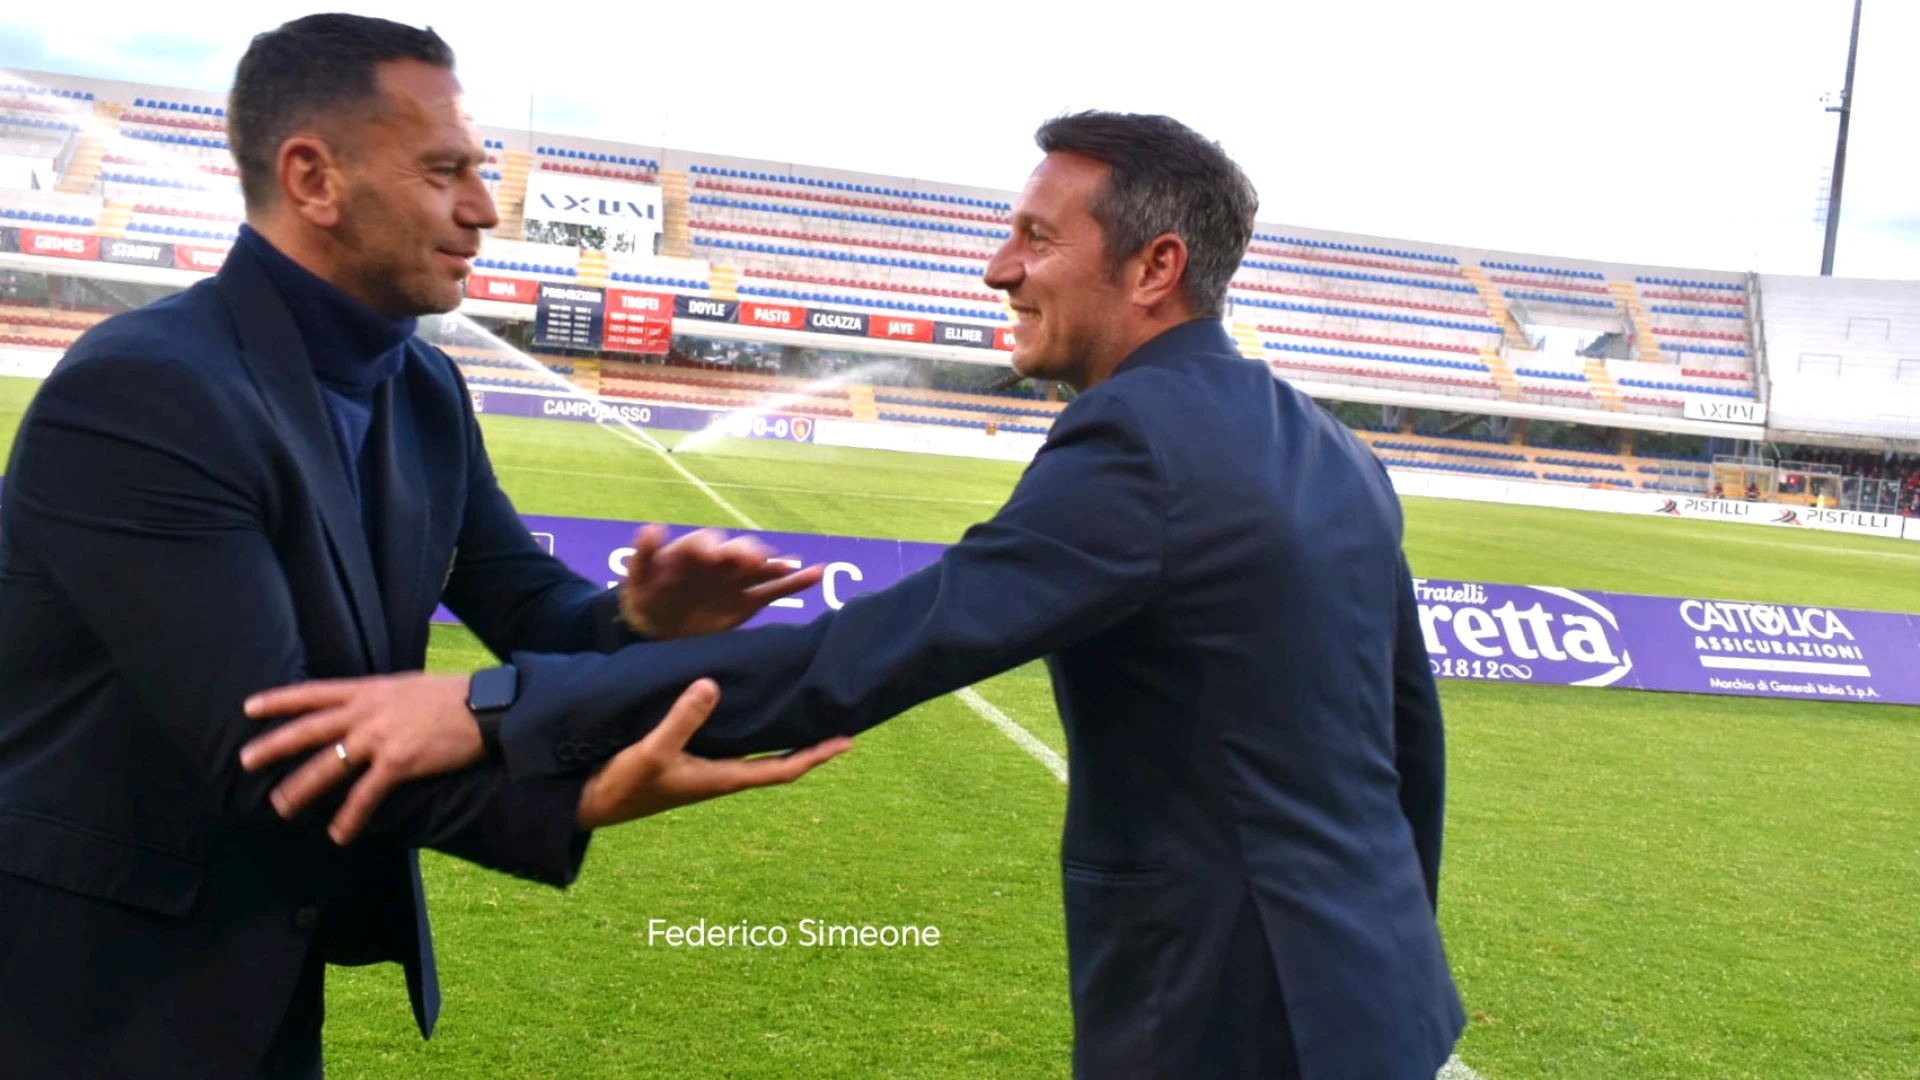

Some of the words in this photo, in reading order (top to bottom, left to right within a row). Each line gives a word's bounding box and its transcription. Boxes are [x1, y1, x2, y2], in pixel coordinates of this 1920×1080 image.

[688, 300, 725, 318] DOYLE
[753, 307, 791, 324] PASTO
[812, 312, 862, 331] CASAZZA
[888, 321, 915, 337] JAYE
[543, 399, 652, 423] CAMPOBASSO
[1684, 499, 1750, 516] PISTILLI
[1806, 510, 1889, 528] PISTILLI
[1412, 578, 1488, 604] Fratelli
[1679, 599, 1856, 641] CATTOLICA
[1417, 600, 1620, 664] retta
[1694, 635, 1864, 660] ASSICURAZIONI
[1442, 658, 1501, 678] 1812
[1709, 677, 1755, 691] Marchio
[1757, 679, 1769, 691] di
[1770, 680, 1816, 694] Generali
[1817, 684, 1845, 696] Italia
